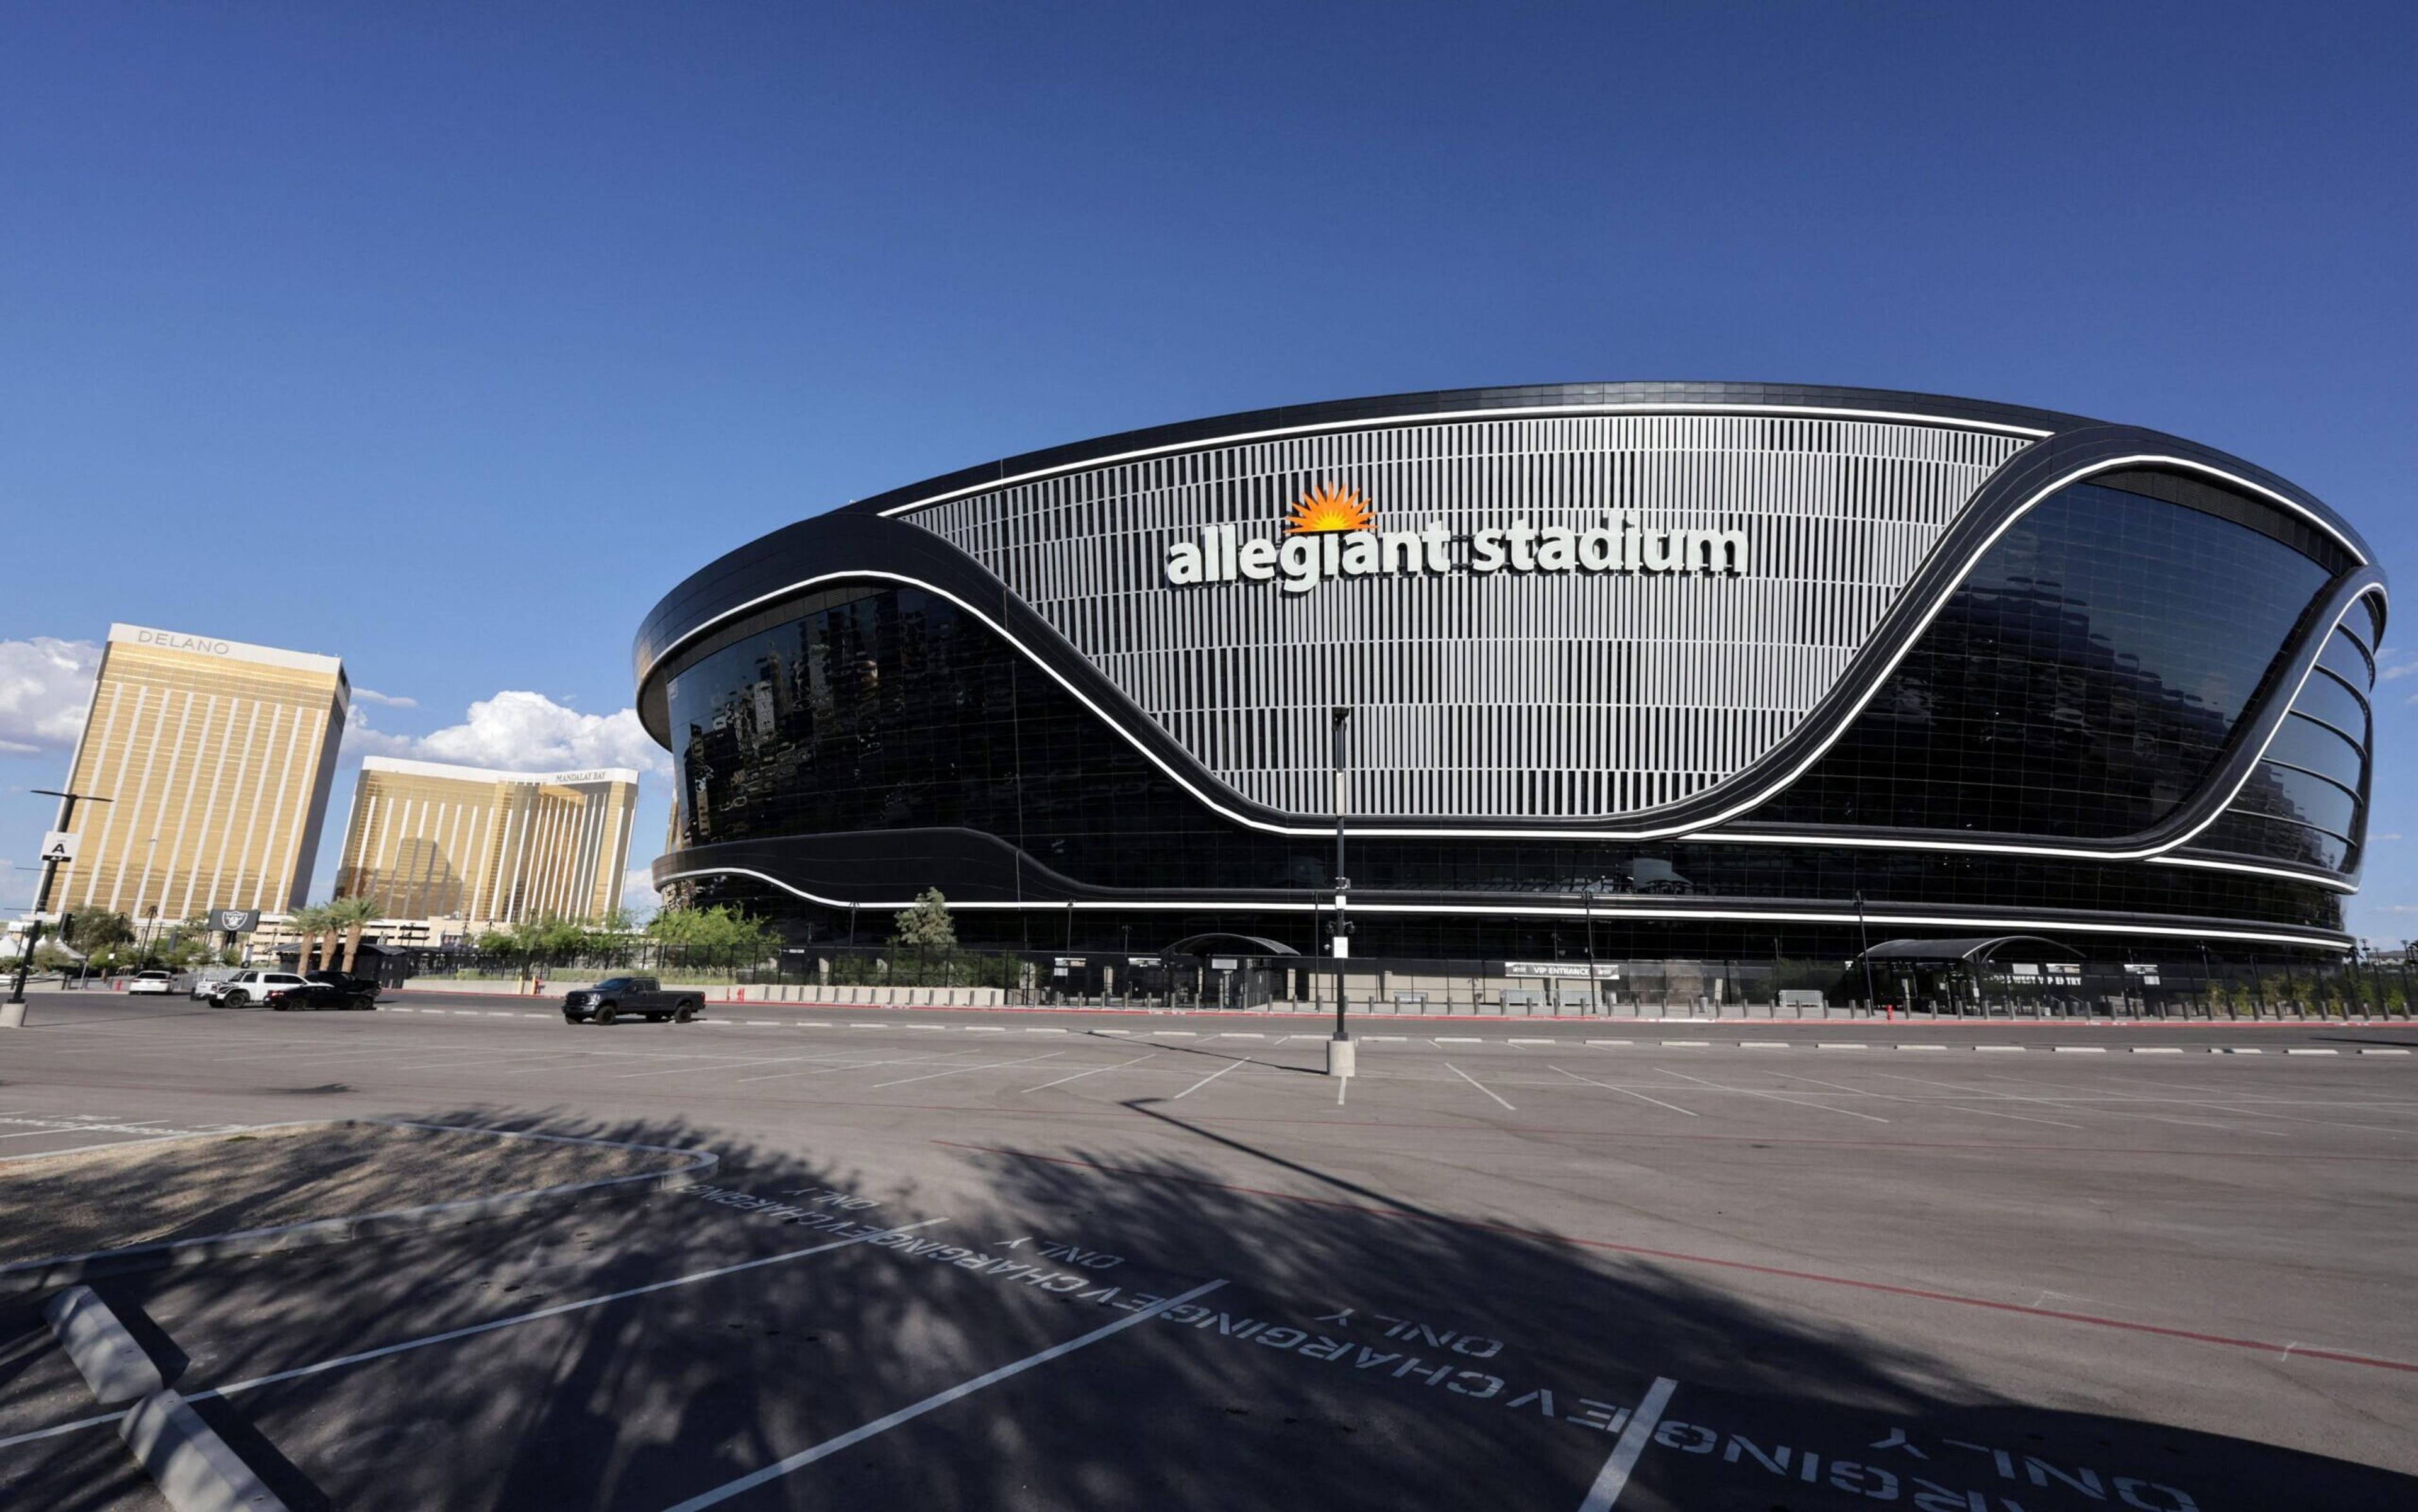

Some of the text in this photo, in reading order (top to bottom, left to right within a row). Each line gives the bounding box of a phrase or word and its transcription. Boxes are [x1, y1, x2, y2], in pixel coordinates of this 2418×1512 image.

[1167, 510, 1749, 593] allegiant stadium
[138, 630, 229, 654] DELANO
[556, 771, 606, 782] MANDALAY BAY
[51, 843, 65, 854] A
[1548, 967, 1590, 975] ENTRANCE
[994, 1237, 1125, 1269] ONLY
[868, 1234, 1166, 1312] EV CHARGING
[1315, 1308, 1504, 1358] ONLY
[1160, 1304, 1632, 1433] EV CHARGING
